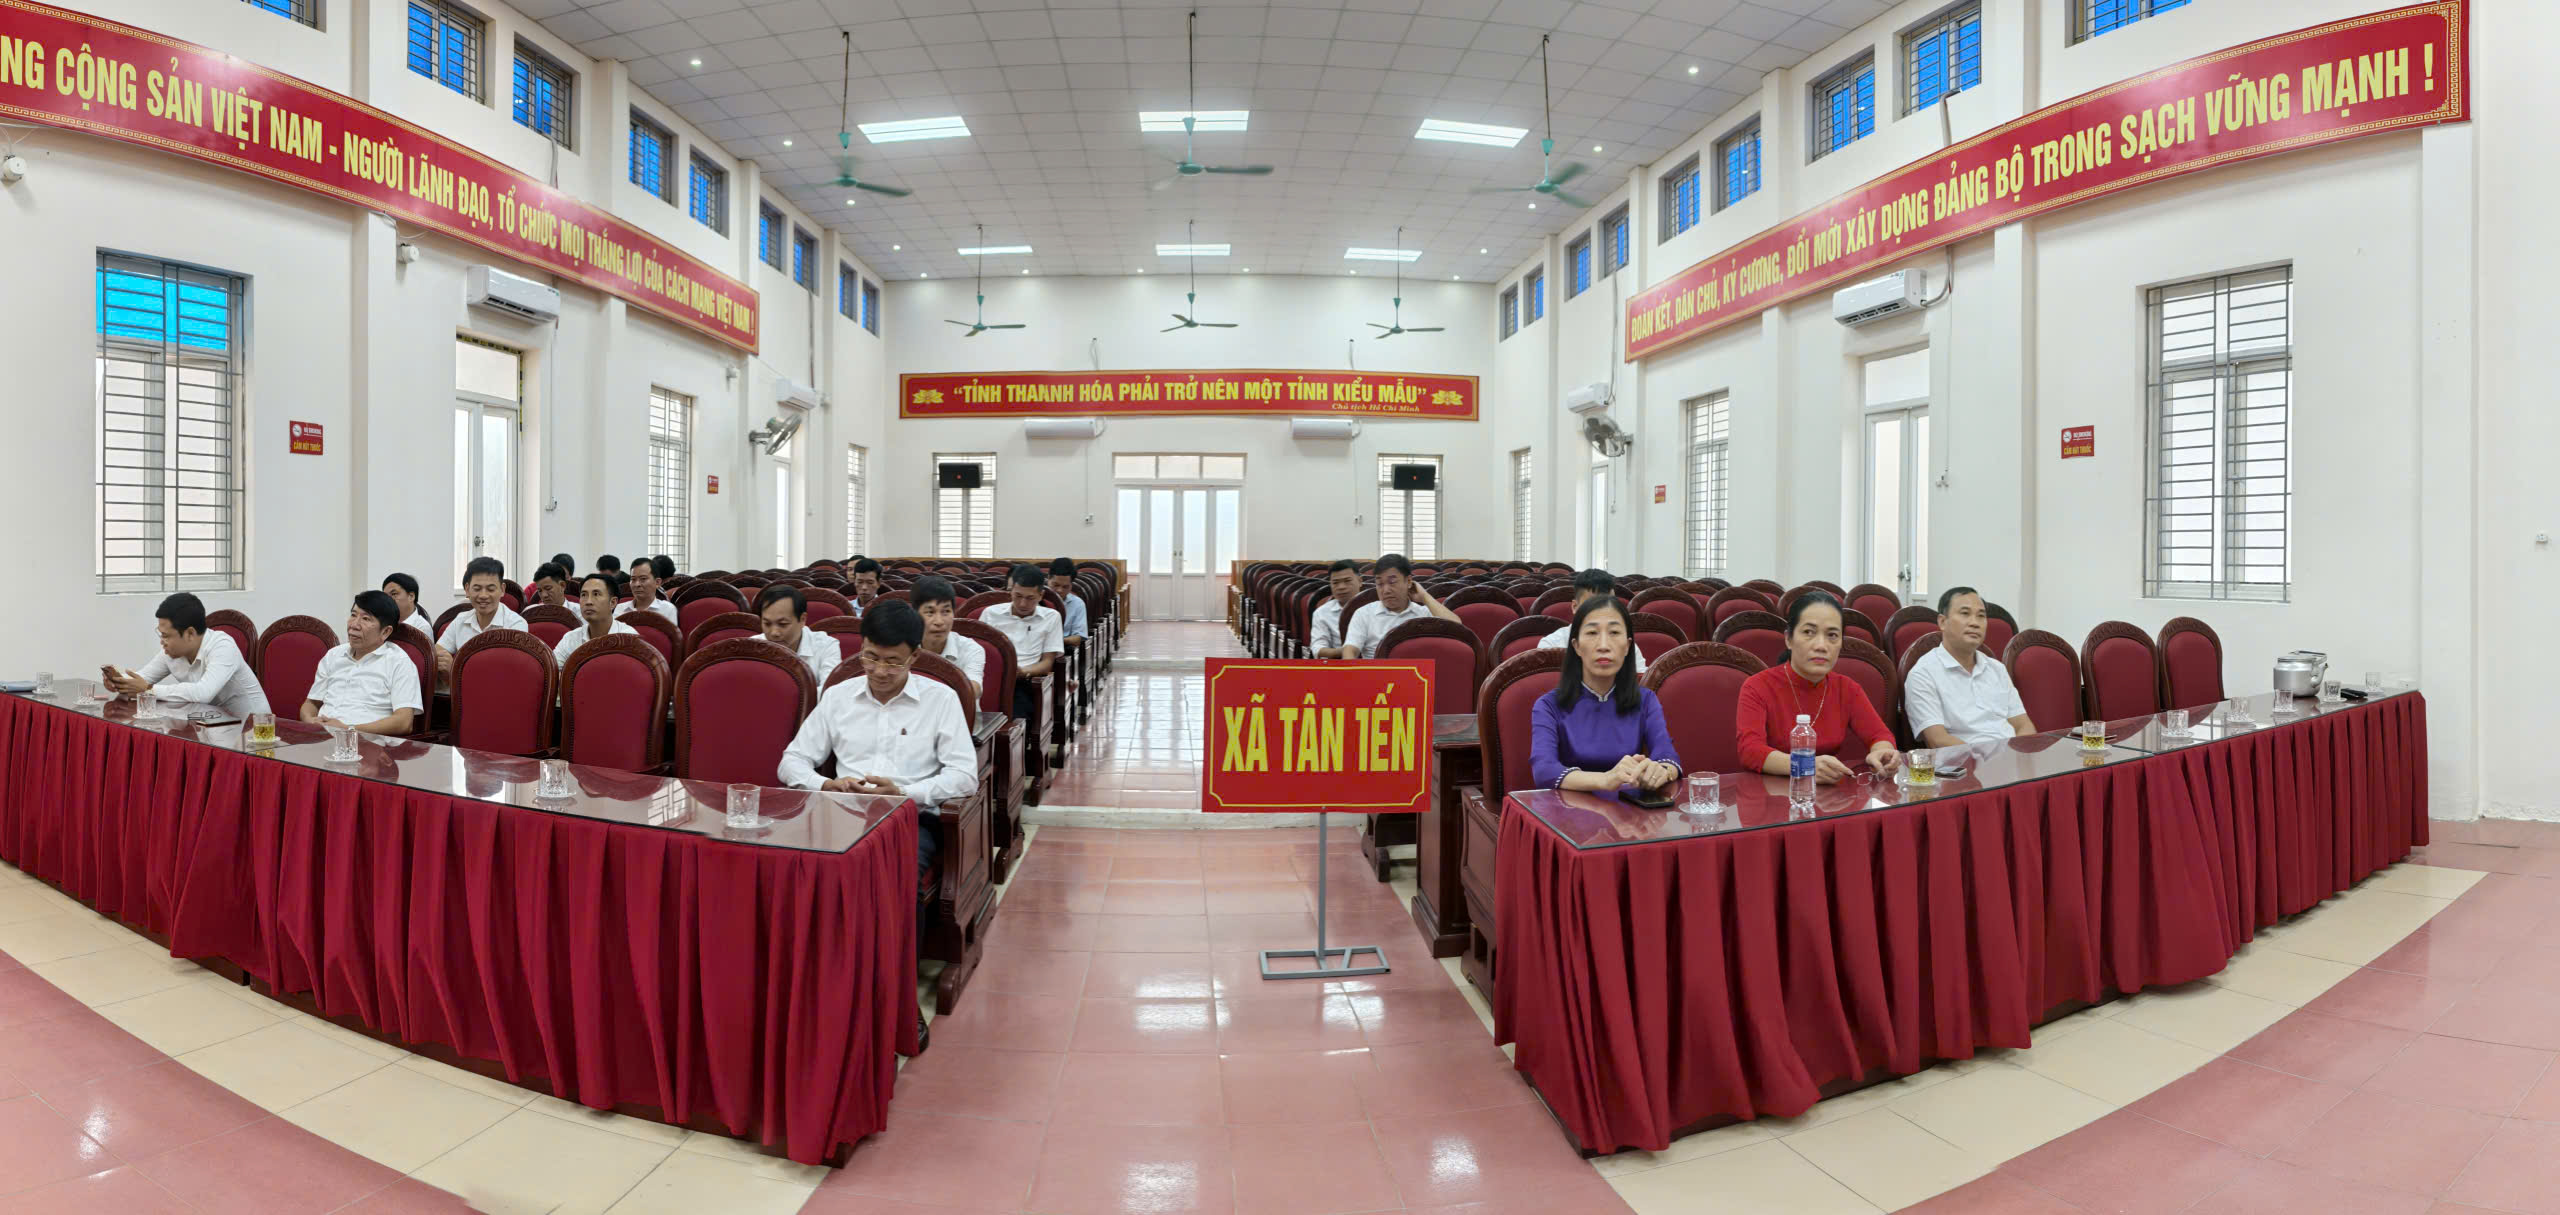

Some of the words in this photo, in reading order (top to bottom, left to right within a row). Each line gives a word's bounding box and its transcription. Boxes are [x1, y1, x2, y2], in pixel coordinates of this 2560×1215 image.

[55, 43, 137, 111] CỘNG
[147, 56, 202, 127] SẢN
[211, 87, 263, 150] VIỆT
[270, 105, 322, 164] NAM
[329, 144, 337, 155] -
[344, 131, 403, 191] NGƯỜI
[409, 153, 453, 210] LÃNH
[458, 176, 493, 231] ĐẠO,
[497, 185, 516, 234] TỔ
[520, 200, 557, 249] CHỨC
[560, 218, 584, 266] MỌI
[587, 228, 624, 278] THẮNG
[626, 248, 642, 290] LỢI
[644, 249, 664, 294] CỦA
[665, 265, 690, 306] CÁCH
[691, 280, 715, 318] MẠNG
[717, 292, 732, 329] VIỆT
[733, 302, 750, 334] NAM
[1631, 305, 1653, 343] ĐOÀN
[1655, 293, 1674, 333] KẾT,
[1675, 288, 1694, 325] DÂN
[1697, 268, 1720, 315] CHỦ,
[1723, 258, 1737, 304] KỶ
[1739, 251, 1783, 297] CƯƠNG,
[1787, 227, 1809, 278] ĐỔI
[1813, 217, 1841, 268] MỚI
[1846, 207, 1876, 255] XÂY
[1881, 189, 1928, 243] DỰNG
[1934, 162, 1988, 221] ĐẢNG
[1995, 144, 2024, 202] BỘ
[2030, 123, 2111, 187] TRONG
[2120, 96, 2195, 164] SẠCH
[2205, 72, 2289, 136] VỮNG
[2302, 47, 2408, 118] MẠNH
[2424, 43, 2433, 91] !
[1079, 380, 1113, 401] HÓA
[1118, 376, 1159, 401] PHẢI
[1164, 375, 1198, 400] TRỞ
[1202, 378, 1238, 400] NÊN
[1244, 378, 1283, 404] MỘT
[1287, 376, 1328, 401] TỈNH
[1333, 376, 1372, 402] KIỂU
[1222, 693, 1268, 772] XÃ
[1279, 693, 1344, 773] TÂN
